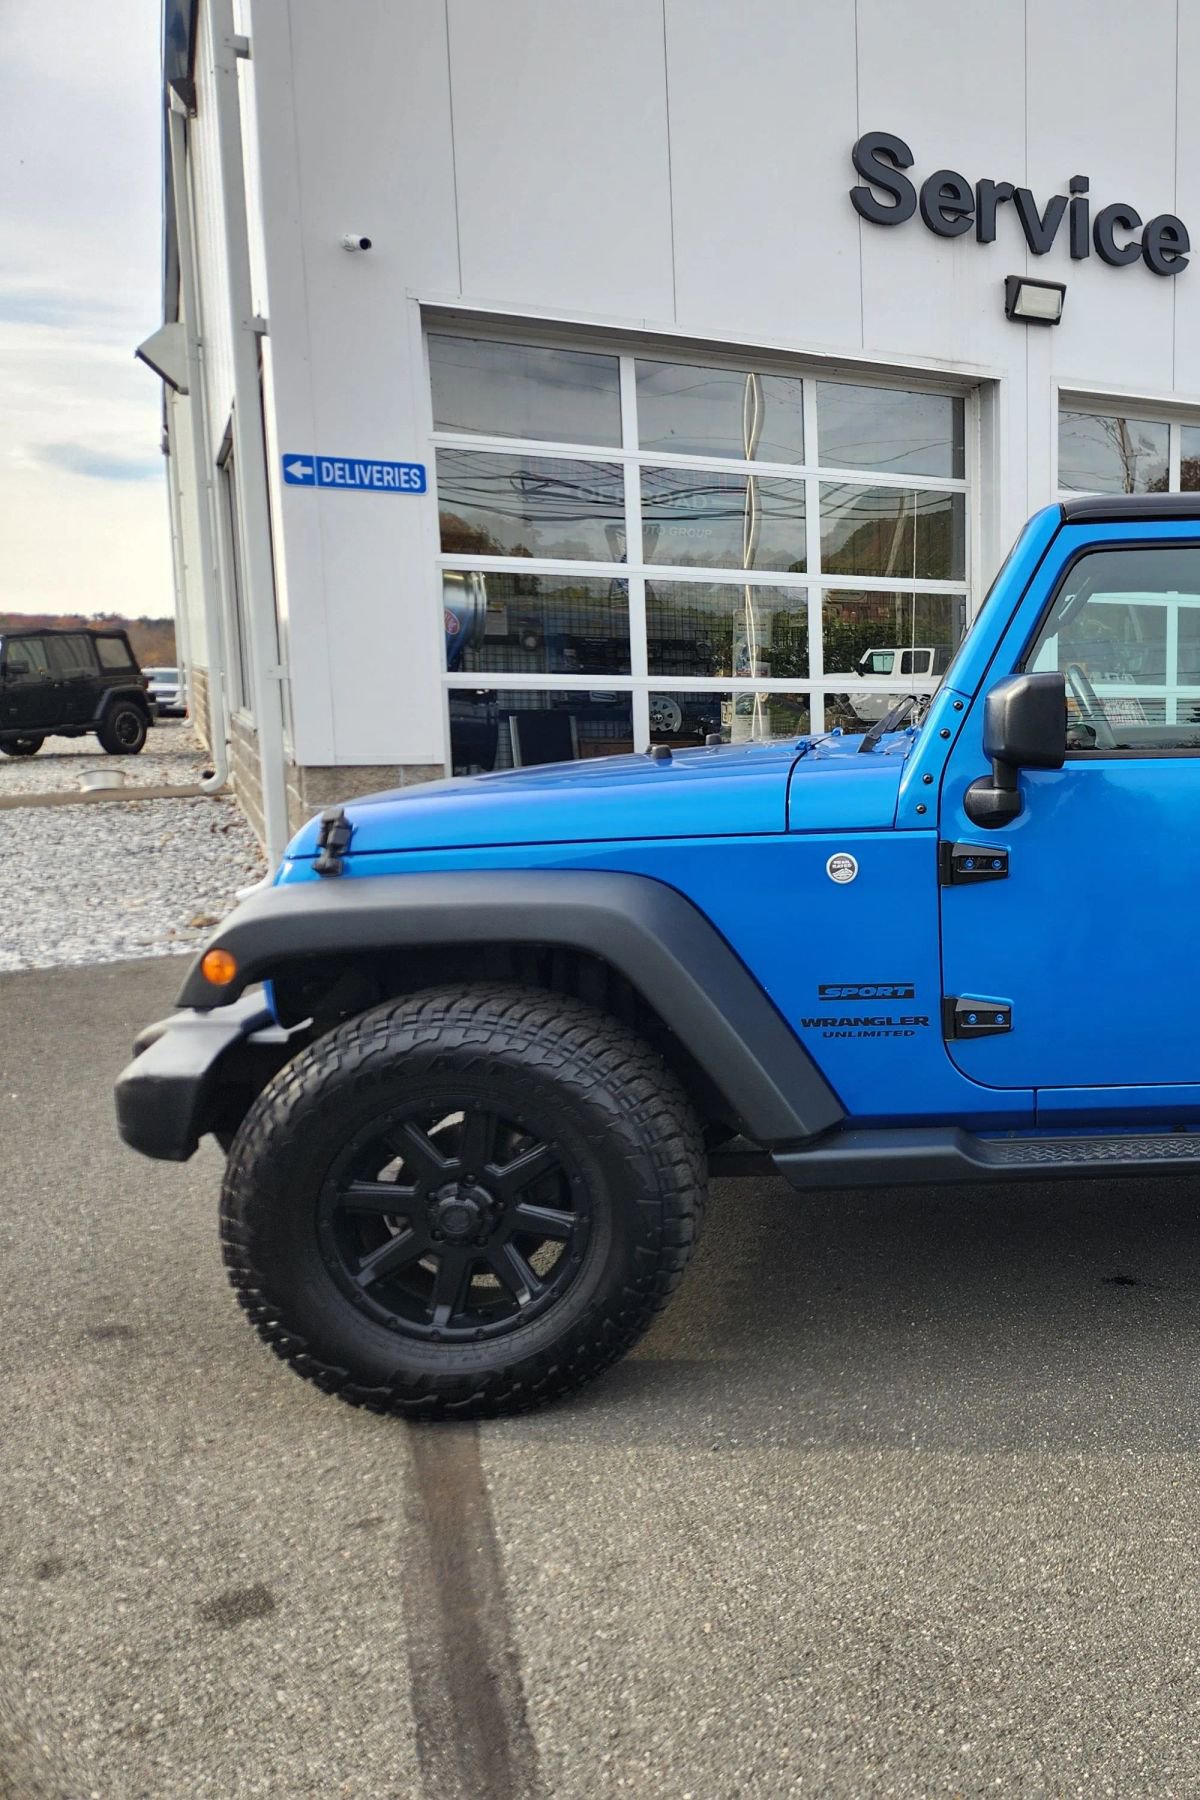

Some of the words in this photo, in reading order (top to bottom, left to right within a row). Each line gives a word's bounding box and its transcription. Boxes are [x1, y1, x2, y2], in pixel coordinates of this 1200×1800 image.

[850, 131, 1191, 277] Service
[321, 461, 422, 489] DELIVERIES
[669, 526, 713, 538] GROUP
[820, 986, 914, 999] SPORT
[800, 1016, 929, 1028] WRANGLER
[823, 1030, 915, 1039] UNLIMITED
